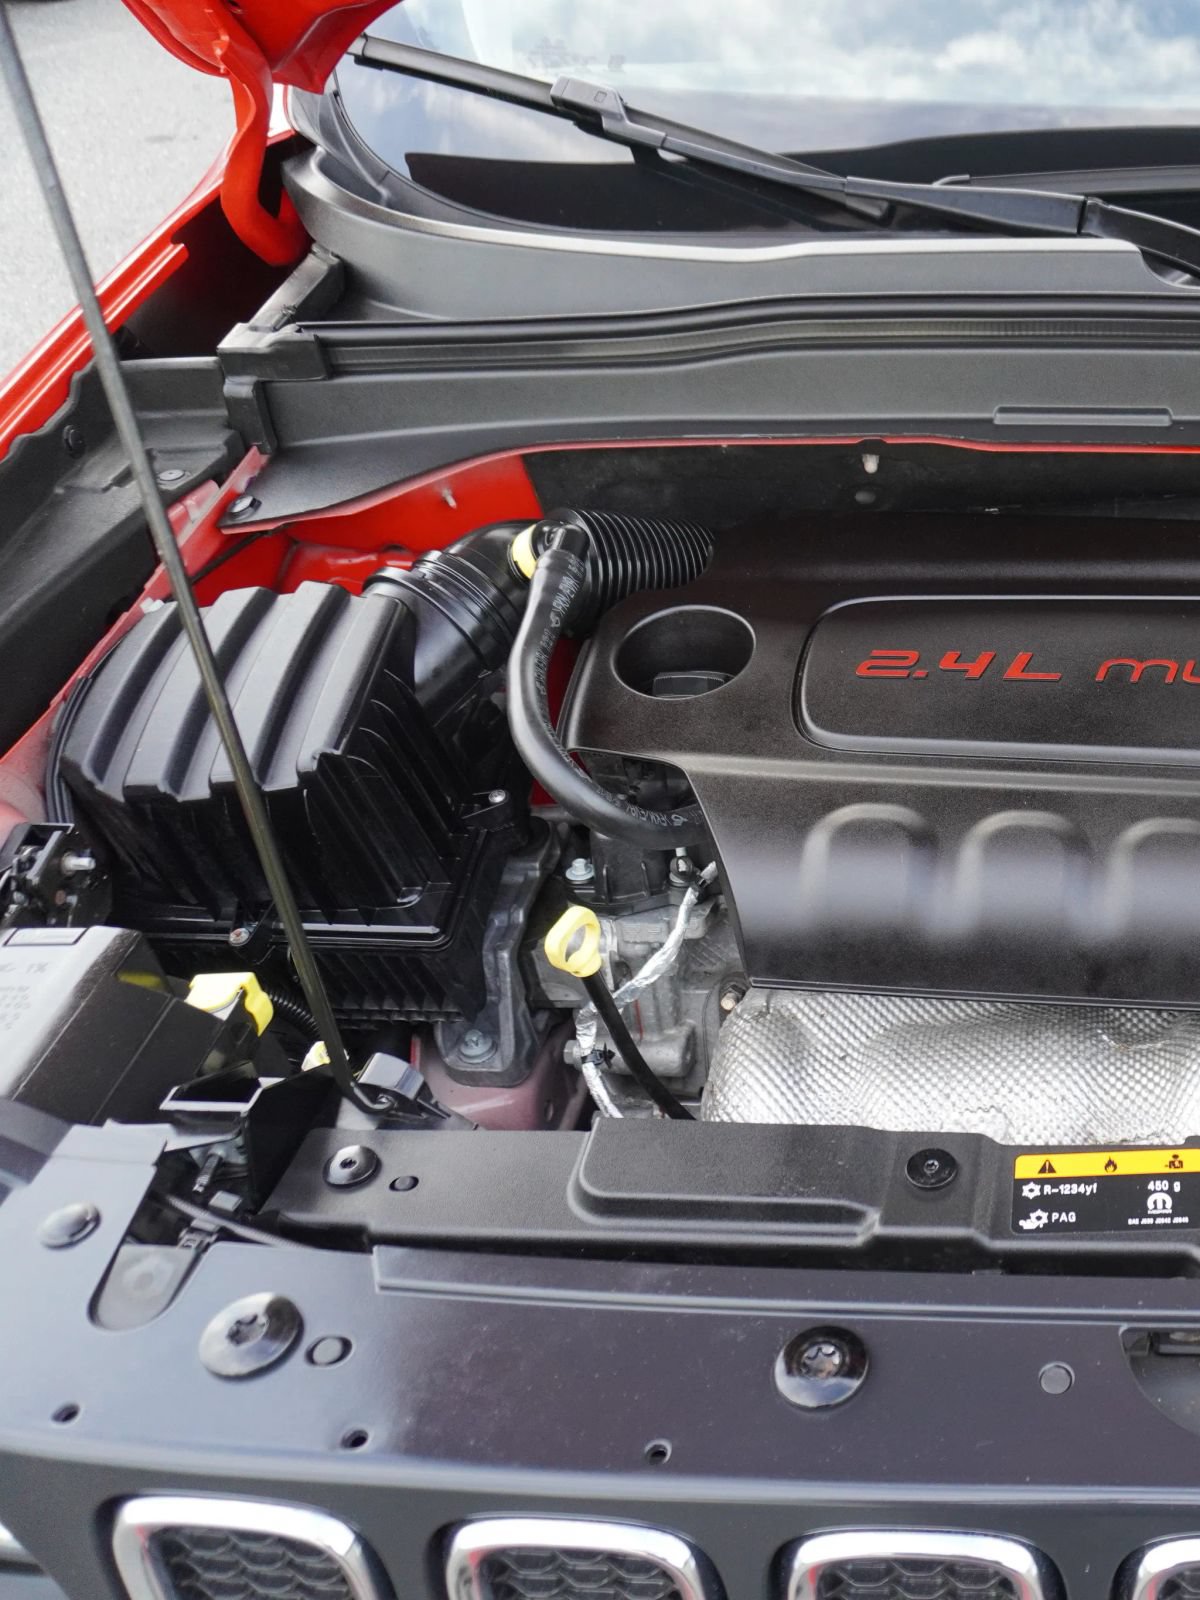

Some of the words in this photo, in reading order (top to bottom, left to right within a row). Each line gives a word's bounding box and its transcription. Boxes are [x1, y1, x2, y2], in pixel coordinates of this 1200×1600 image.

[855, 649, 1062, 681] 2.4L
[1043, 1183, 1098, 1195] R-1234yf
[1147, 1180, 1169, 1192] 450
[1173, 1181, 1181, 1193] g
[1051, 1212, 1076, 1223] PAG
